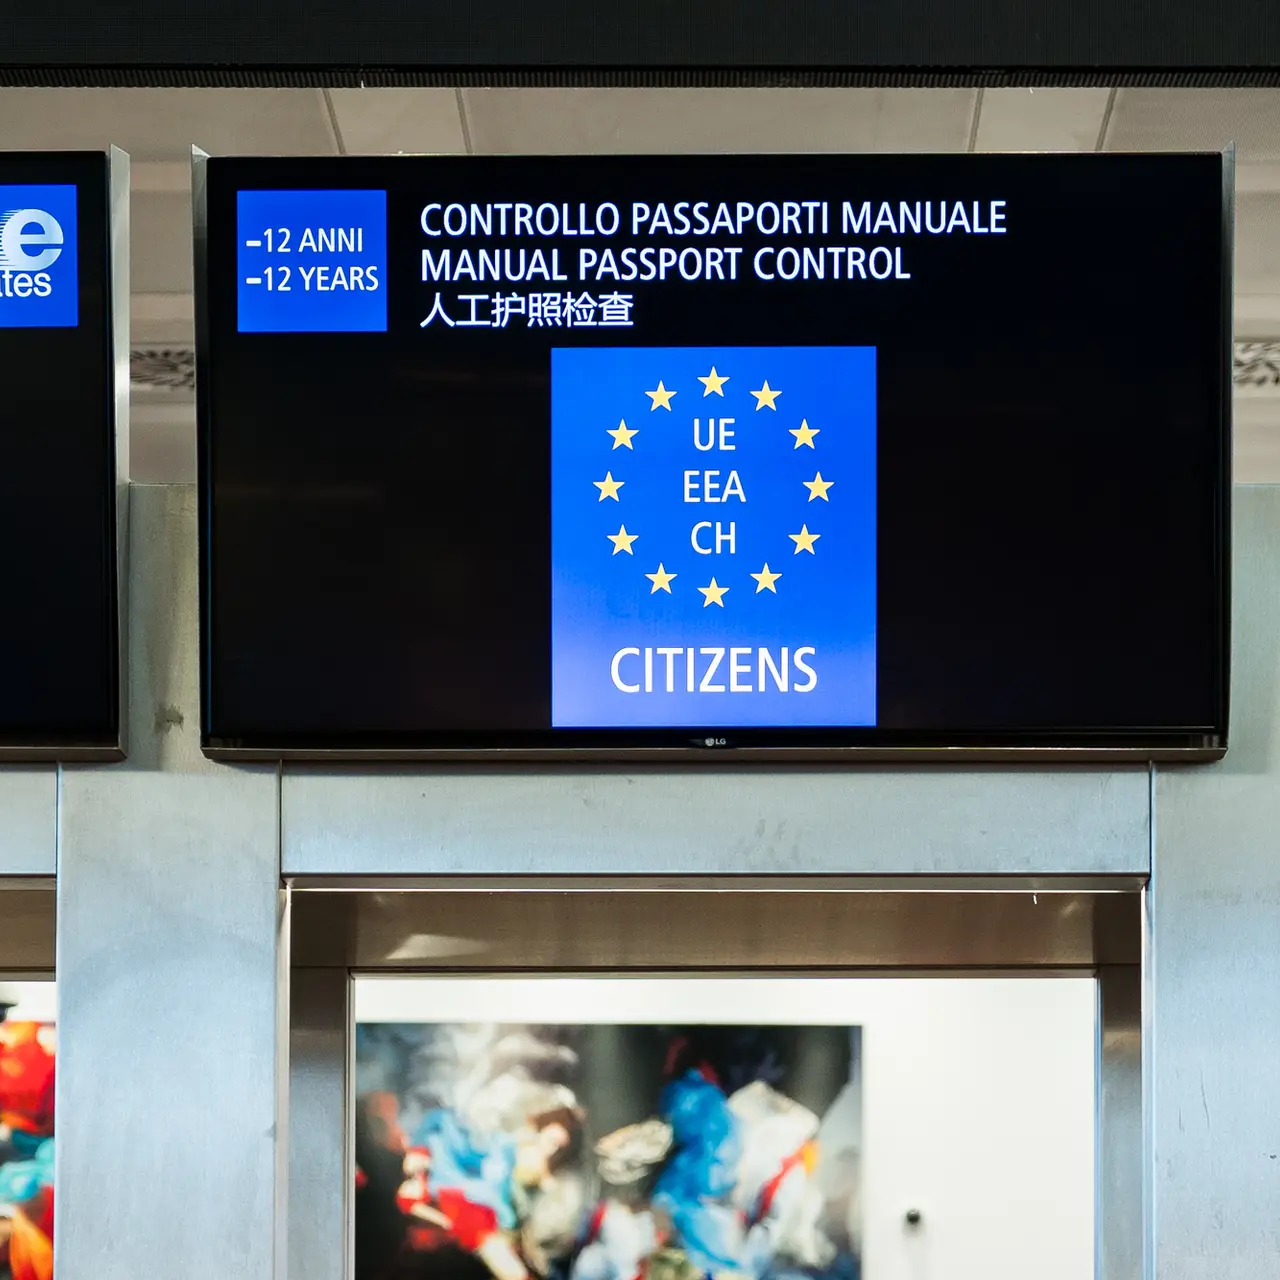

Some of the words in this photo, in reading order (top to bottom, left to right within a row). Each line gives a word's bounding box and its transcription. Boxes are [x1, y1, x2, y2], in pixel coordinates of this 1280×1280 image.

[420, 202, 620, 237] CONTROLLO
[632, 201, 828, 235] PASSAPORTI
[842, 200, 1007, 234] MANUALE
[1, 209, 64, 271] e
[298, 227, 363, 253] ANNI
[298, 265, 379, 292] YEARS
[421, 248, 568, 282] MANUAL
[579, 247, 743, 281] PASSPORT
[753, 246, 911, 280] CONTROL
[419, 290, 634, 328] 人工护照检查
[693, 417, 736, 451] UE
[683, 470, 747, 503] EEA
[690, 521, 736, 555] CH
[610, 646, 818, 694] CITIZENS
